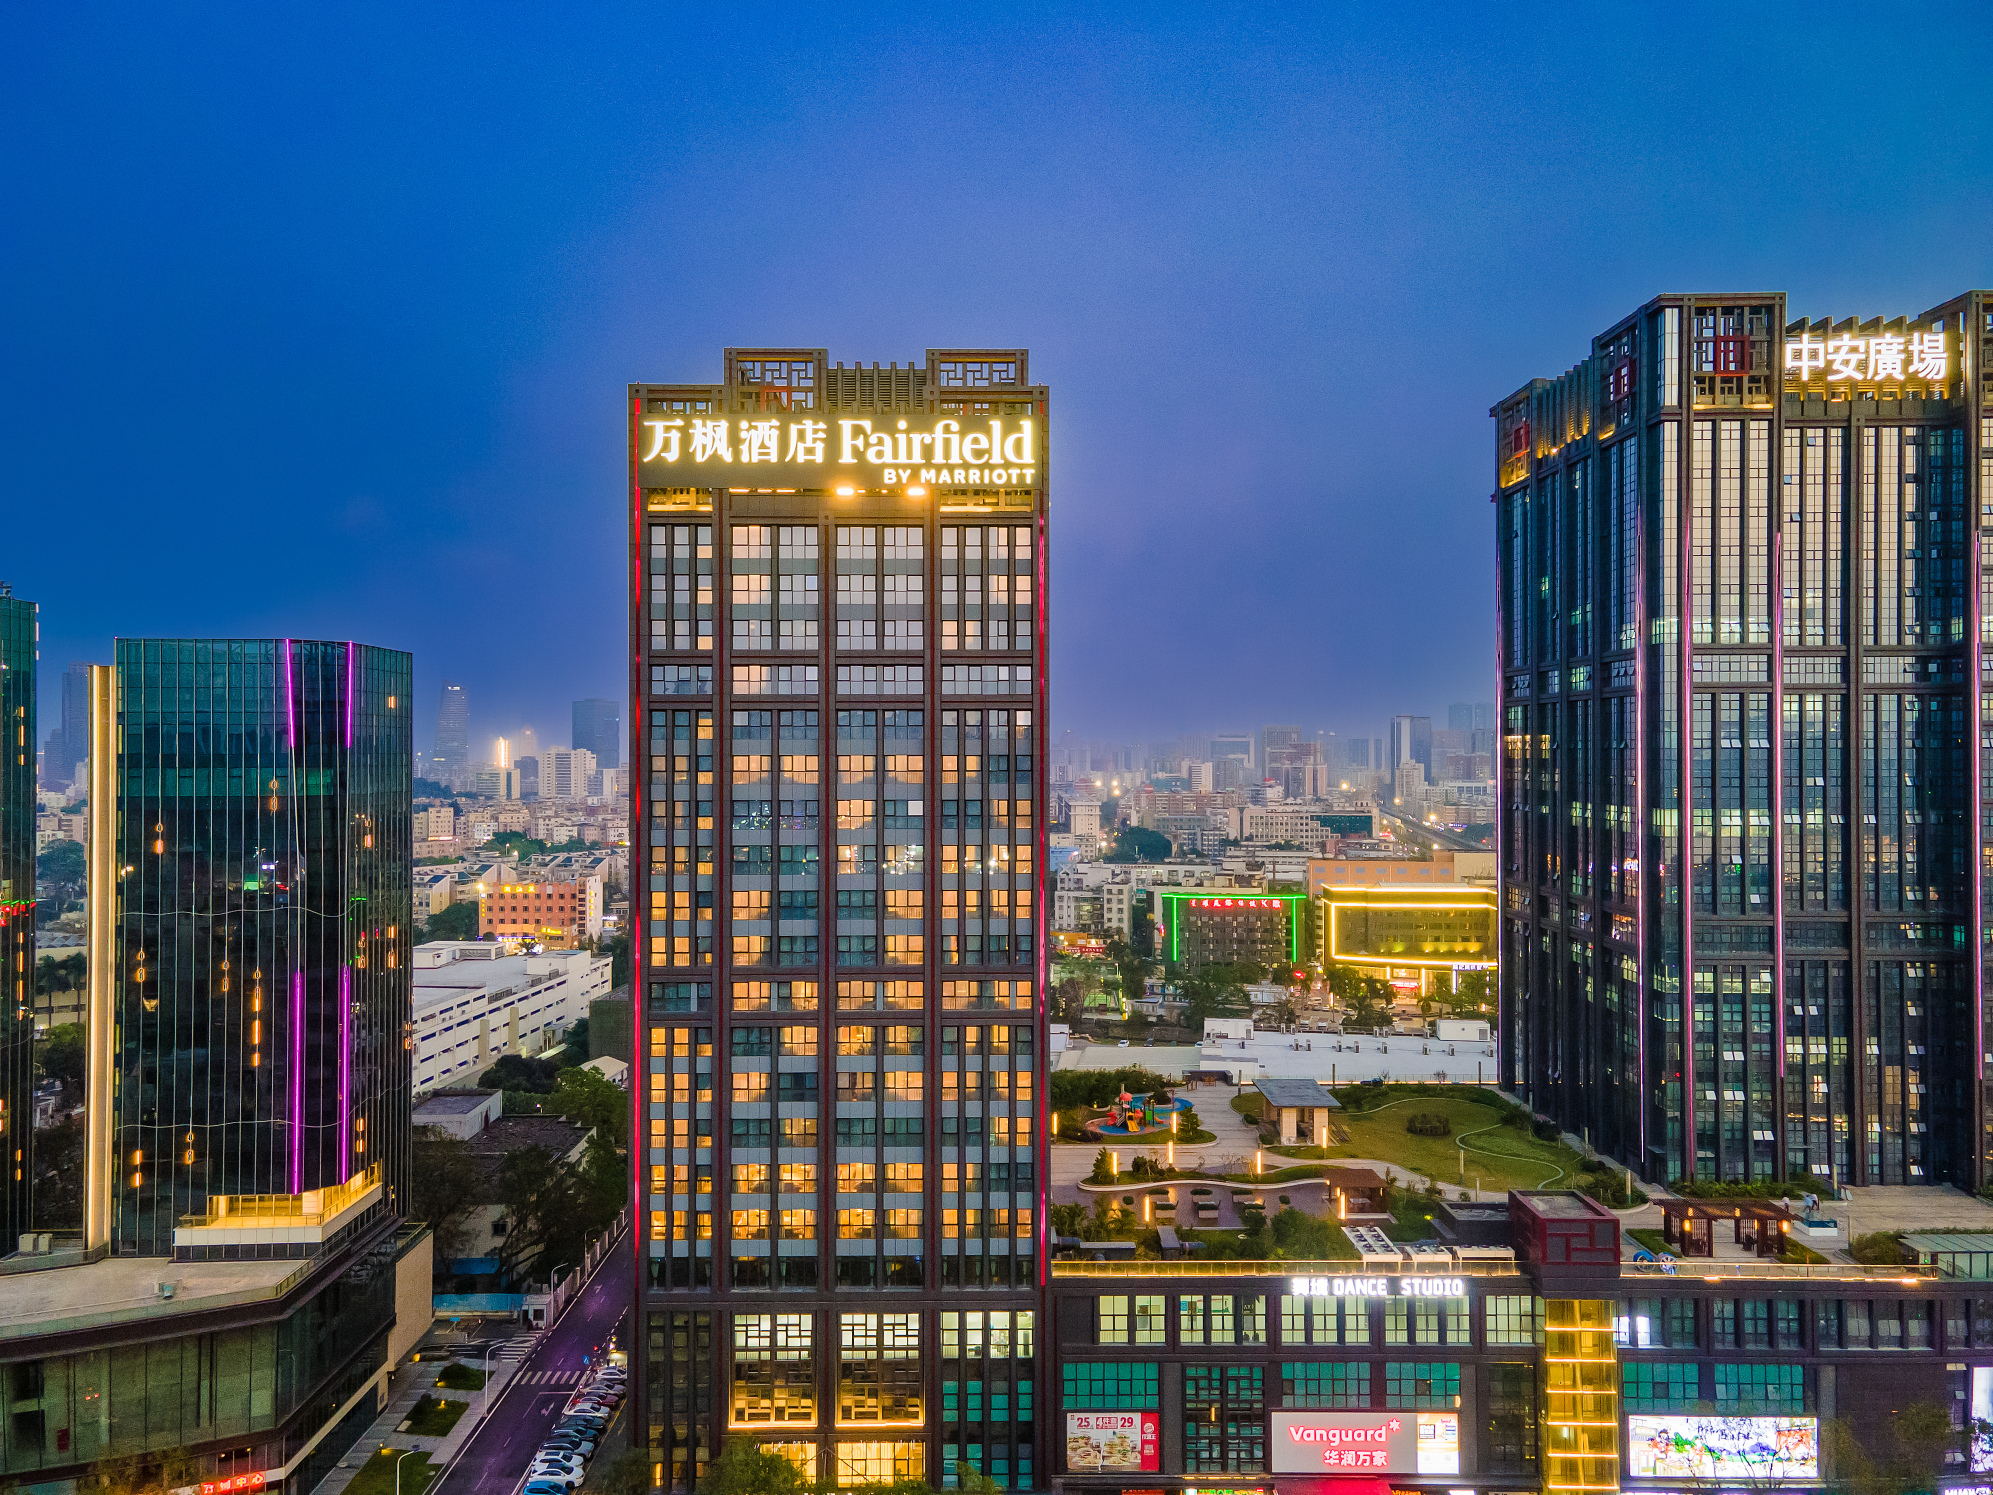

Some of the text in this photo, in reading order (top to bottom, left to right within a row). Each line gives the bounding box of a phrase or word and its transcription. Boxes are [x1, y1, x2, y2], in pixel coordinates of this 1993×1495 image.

[1784, 332, 1949, 381] 中安廣場
[643, 418, 1036, 465] 万枫酒店 Fairfield
[883, 468, 1036, 485] BY MARRIOTT
[1332, 1278, 1388, 1296] DANCE
[1400, 1278, 1464, 1296] STUDIO
[1076, 1416, 1091, 1428] 25
[1120, 1416, 1134, 1428] 29
[1289, 1425, 1387, 1447] Vanguard
[1323, 1449, 1388, 1467] 华润万家
